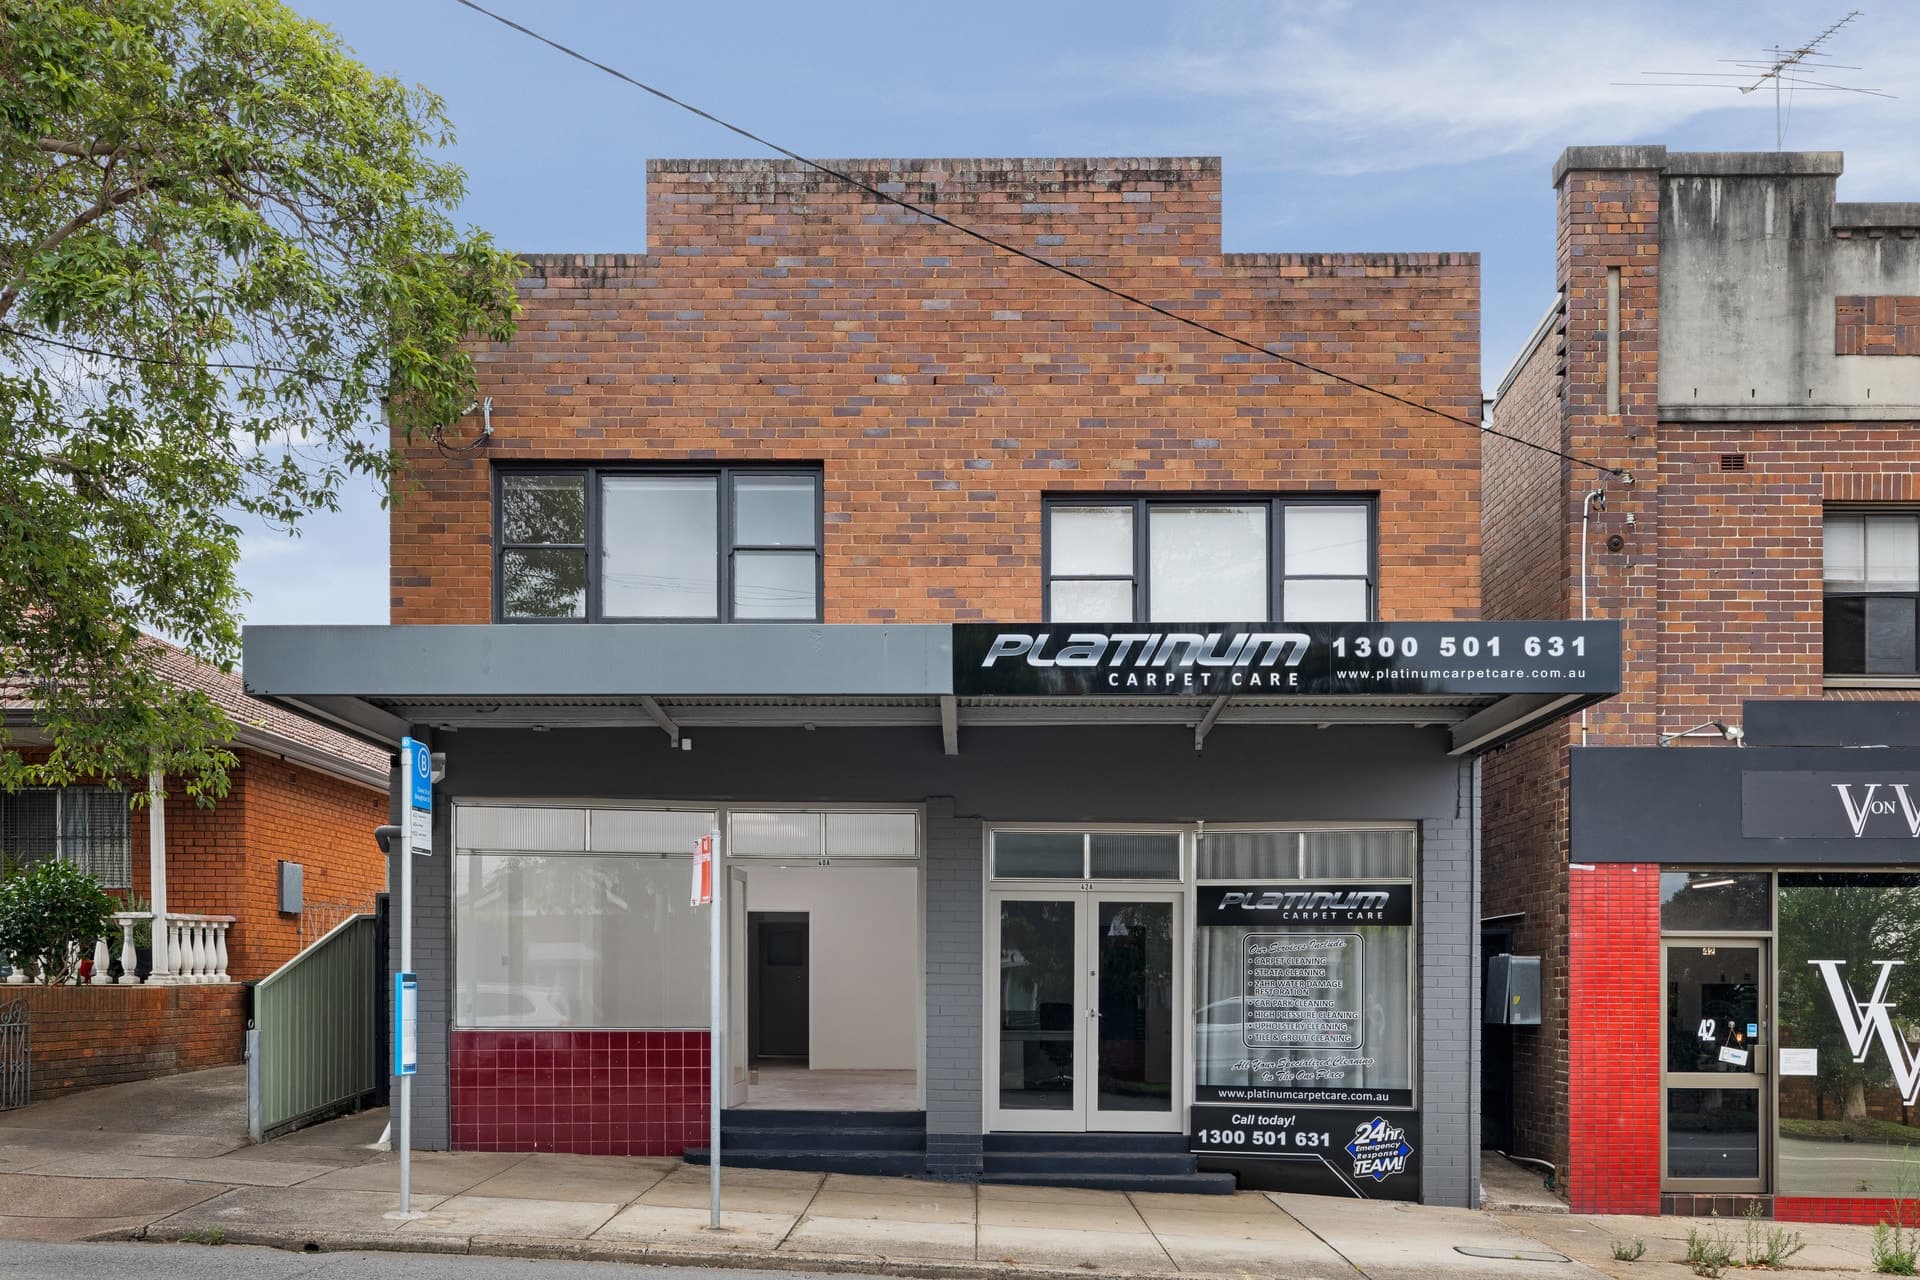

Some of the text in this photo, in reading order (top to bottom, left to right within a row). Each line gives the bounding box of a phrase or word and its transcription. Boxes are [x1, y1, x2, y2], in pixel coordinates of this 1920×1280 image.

[982, 633, 1311, 667] PLATINUM
[1332, 636, 1585, 658] 1300 501 631
[1108, 672, 1299, 687] CARPET CARE
[1336, 667, 1586, 681] www.platinumcarpetcare.com.au
[421, 755, 427, 771] B
[1218, 892, 1390, 910] PLATINUM
[1282, 911, 1384, 920] CARPET CARE
[1249, 944, 1267, 954] Our
[1268, 942, 1307, 953] Services
[1254, 957, 1327, 966] CARPET CLEANING
[1254, 968, 1325, 977] STRATA CLEANING
[1254, 980, 1343, 988] 24HR WATER DAMAGE
[1255, 988, 1310, 997] RESTORATION
[1254, 1000, 1335, 1008] CAR PARK CLEANING
[1254, 1011, 1359, 1020] HIGH PRESSURE CLEANING
[1255, 1022, 1347, 1031] UPHOLSTERY CLEANING
[1697, 1019, 1716, 1041] 42
[1254, 1034, 1351, 1043] TILE & GROUT CLEANING
[1231, 1059, 1249, 1071] All
[1251, 1058, 1276, 1071] Your
[1332, 1056, 1375, 1068] Cleaning
[1261, 1069, 1345, 1081] In The One Place
[1218, 1088, 1390, 1102] www.platinumcarpetcare.com.au
[1231, 1114, 1296, 1128] Call today!
[1198, 1129, 1330, 1147] 1300 501 631
[1355, 1142, 1401, 1152] Emergency
[1356, 1150, 1399, 1160] Response
[1355, 1156, 1404, 1174] TEAM!
